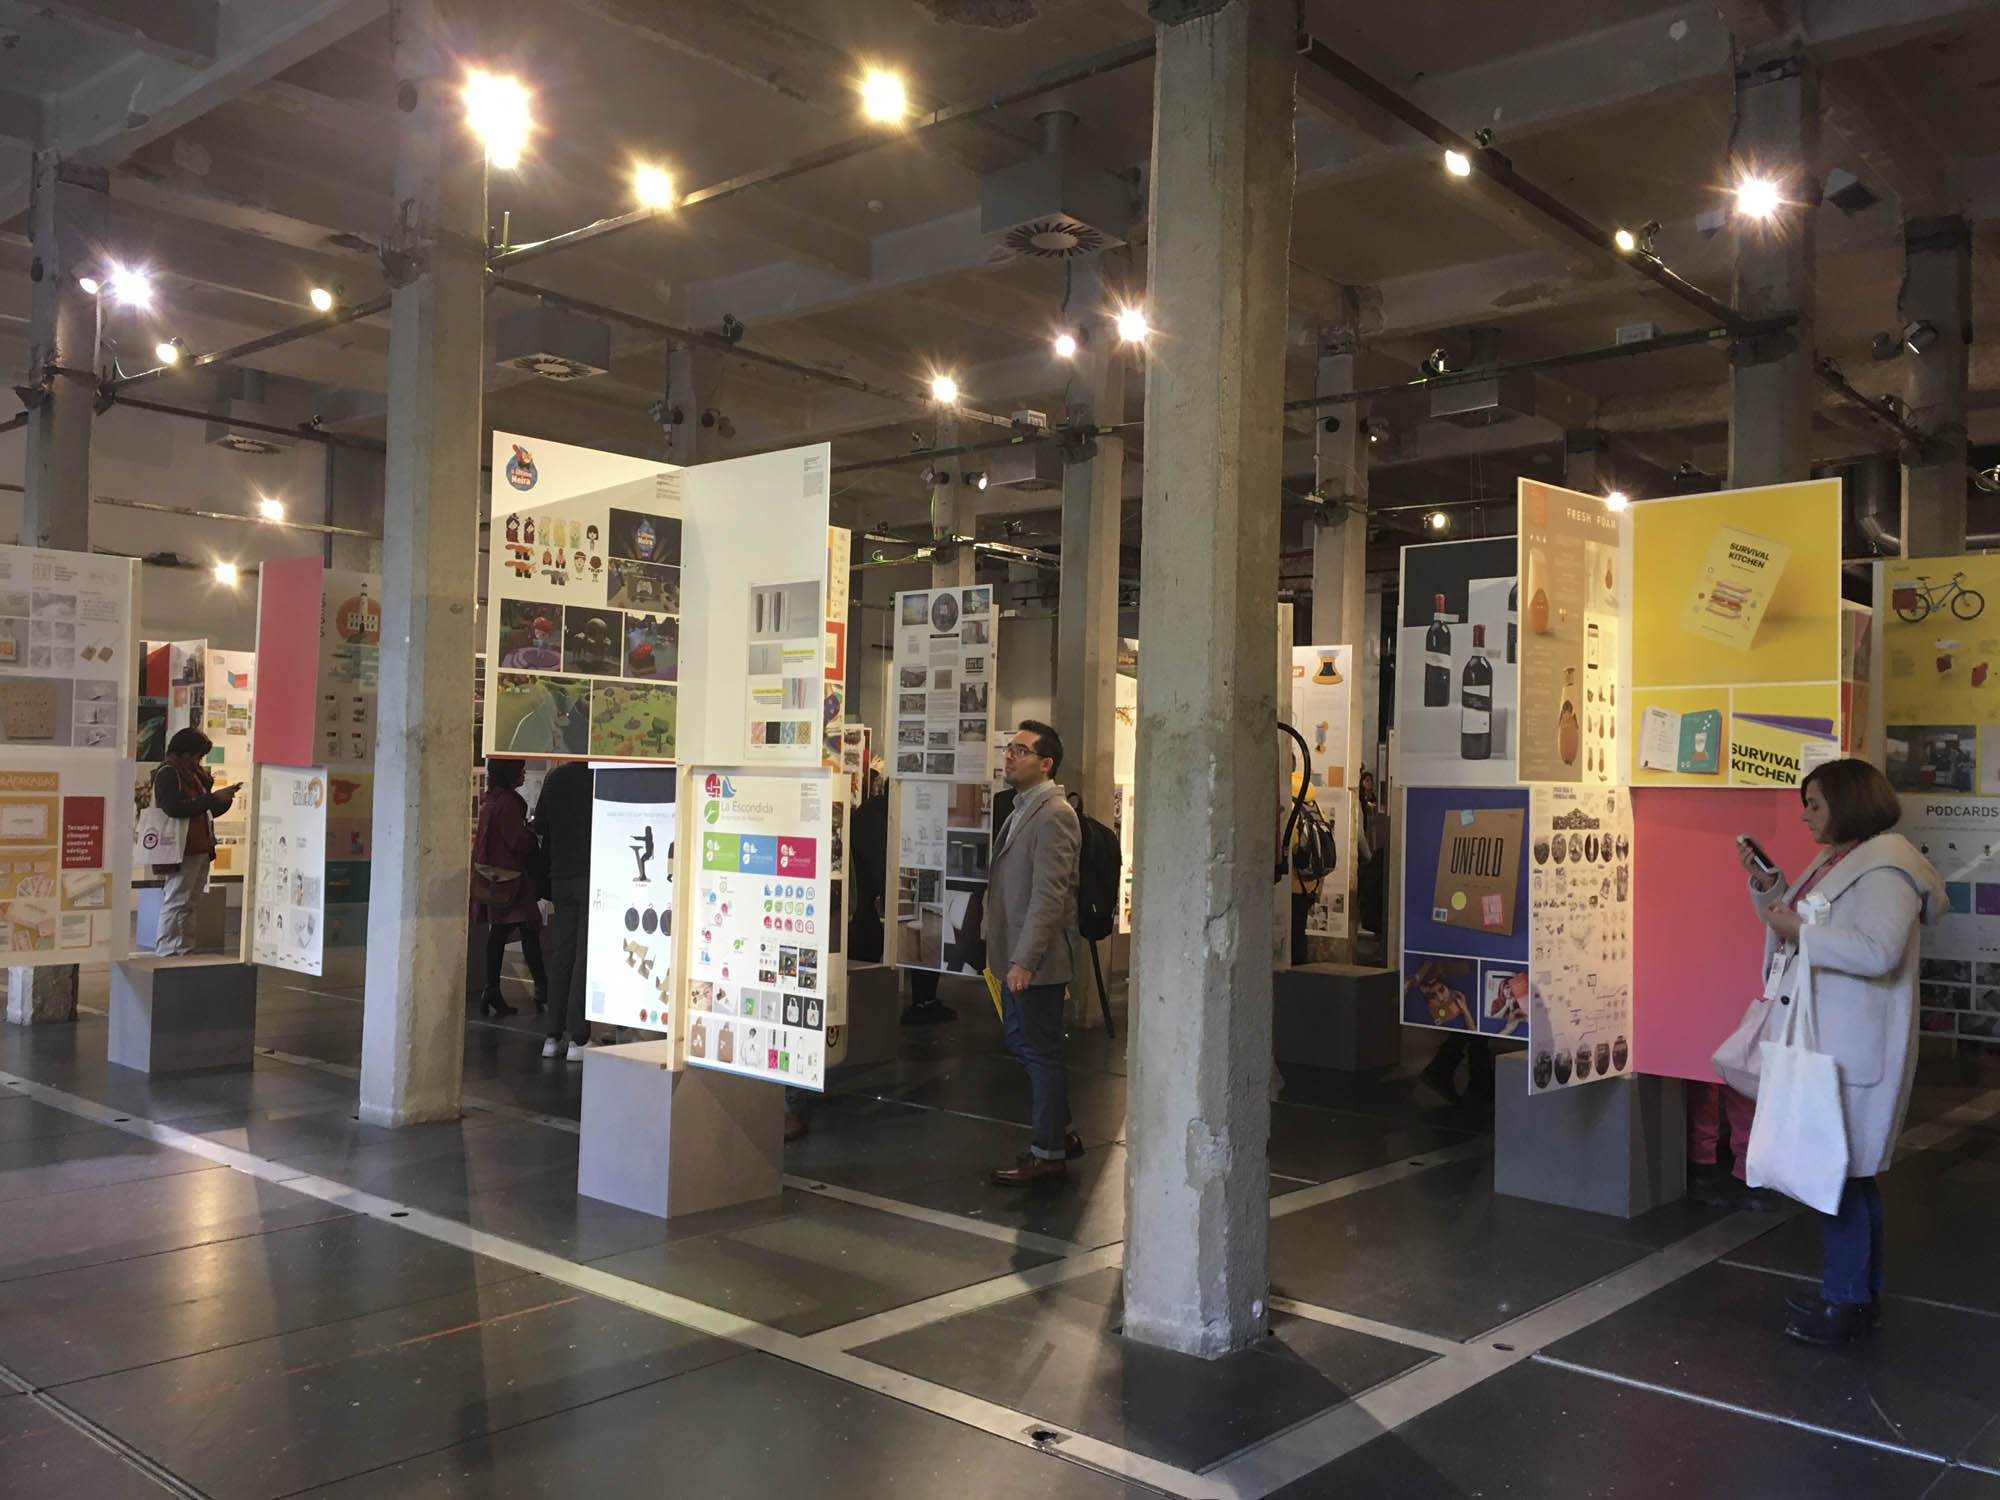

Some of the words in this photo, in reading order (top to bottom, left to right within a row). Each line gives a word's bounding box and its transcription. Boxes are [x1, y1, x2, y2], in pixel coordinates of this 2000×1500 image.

[1566, 507, 1592, 523] FRESH
[1596, 515, 1616, 528] FOAM
[1728, 551, 1765, 568] KITCHEN
[1729, 542, 1770, 560] SURVIVAL
[1731, 742, 1801, 771] SURVIVAL
[1731, 758, 1797, 785] KITCHEN
[720, 801, 730, 812] La
[732, 800, 774, 814] Escondida
[1926, 805, 1999, 818] PODCARDS
[1450, 836, 1504, 877] UNFOLD
